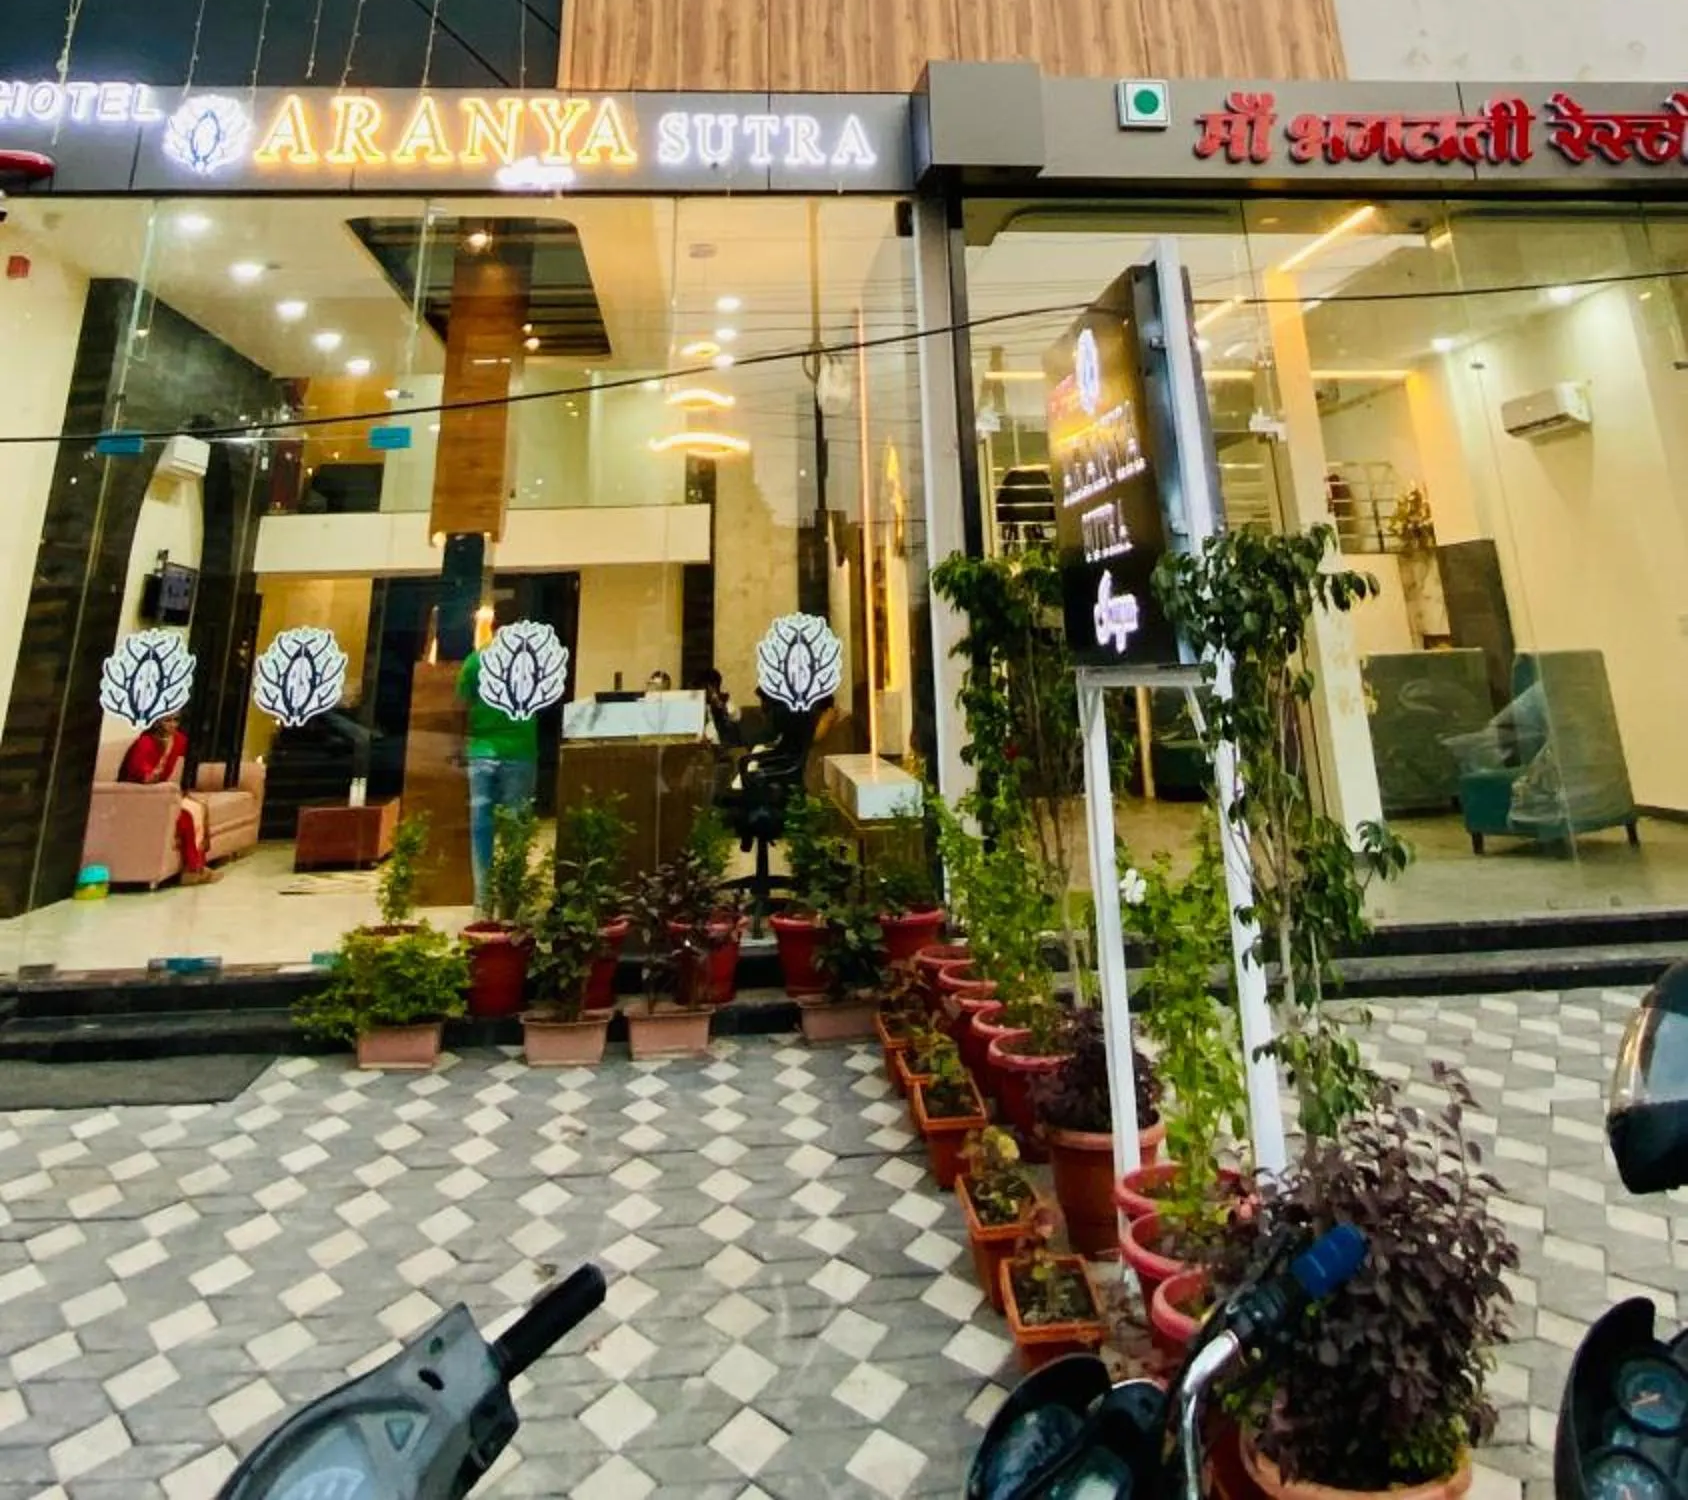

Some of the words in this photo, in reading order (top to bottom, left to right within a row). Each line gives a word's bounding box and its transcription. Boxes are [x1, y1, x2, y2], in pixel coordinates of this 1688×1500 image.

[0, 80, 161, 121] HOTEL
[255, 95, 638, 165] ARANYA
[659, 112, 877, 166] SUTRA
[1286, 92, 1535, 164] भगवती
